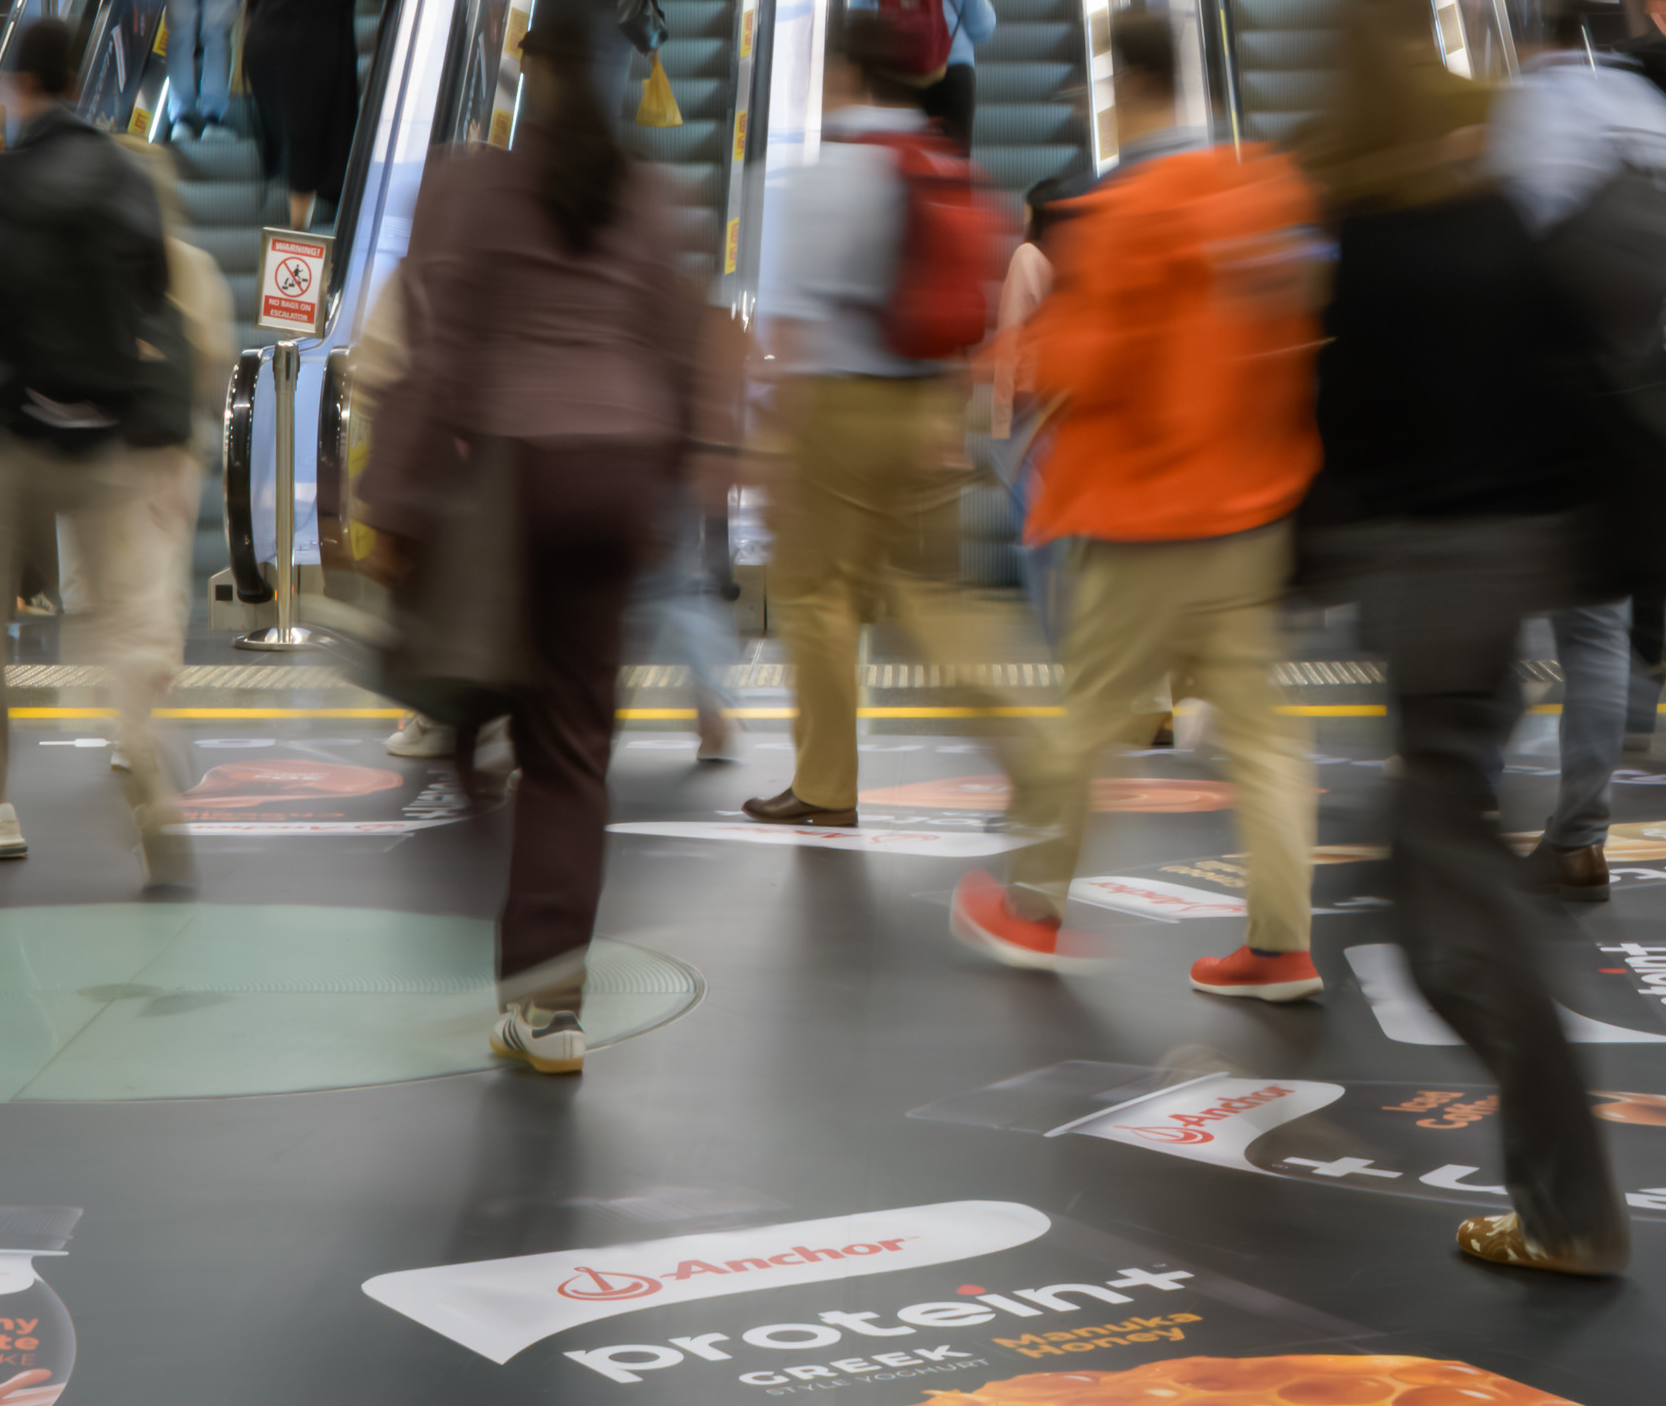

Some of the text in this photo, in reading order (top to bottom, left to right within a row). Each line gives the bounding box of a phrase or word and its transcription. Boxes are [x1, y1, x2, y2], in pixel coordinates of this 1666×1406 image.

[275, 241, 323, 258] WARNING!
[268, 297, 311, 312] NO BAGS ON
[270, 308, 309, 322] ESCALATOR
[1168, 1084, 1296, 1128] Anchor
[1381, 1090, 1465, 1112] Iced
[659, 1236, 909, 1283] Anchor
[562, 1263, 1197, 1384] protein+
[991, 1311, 1205, 1354] Manuka
[1015, 1326, 1186, 1360] Honey
[738, 1342, 959, 1386] GREEK
